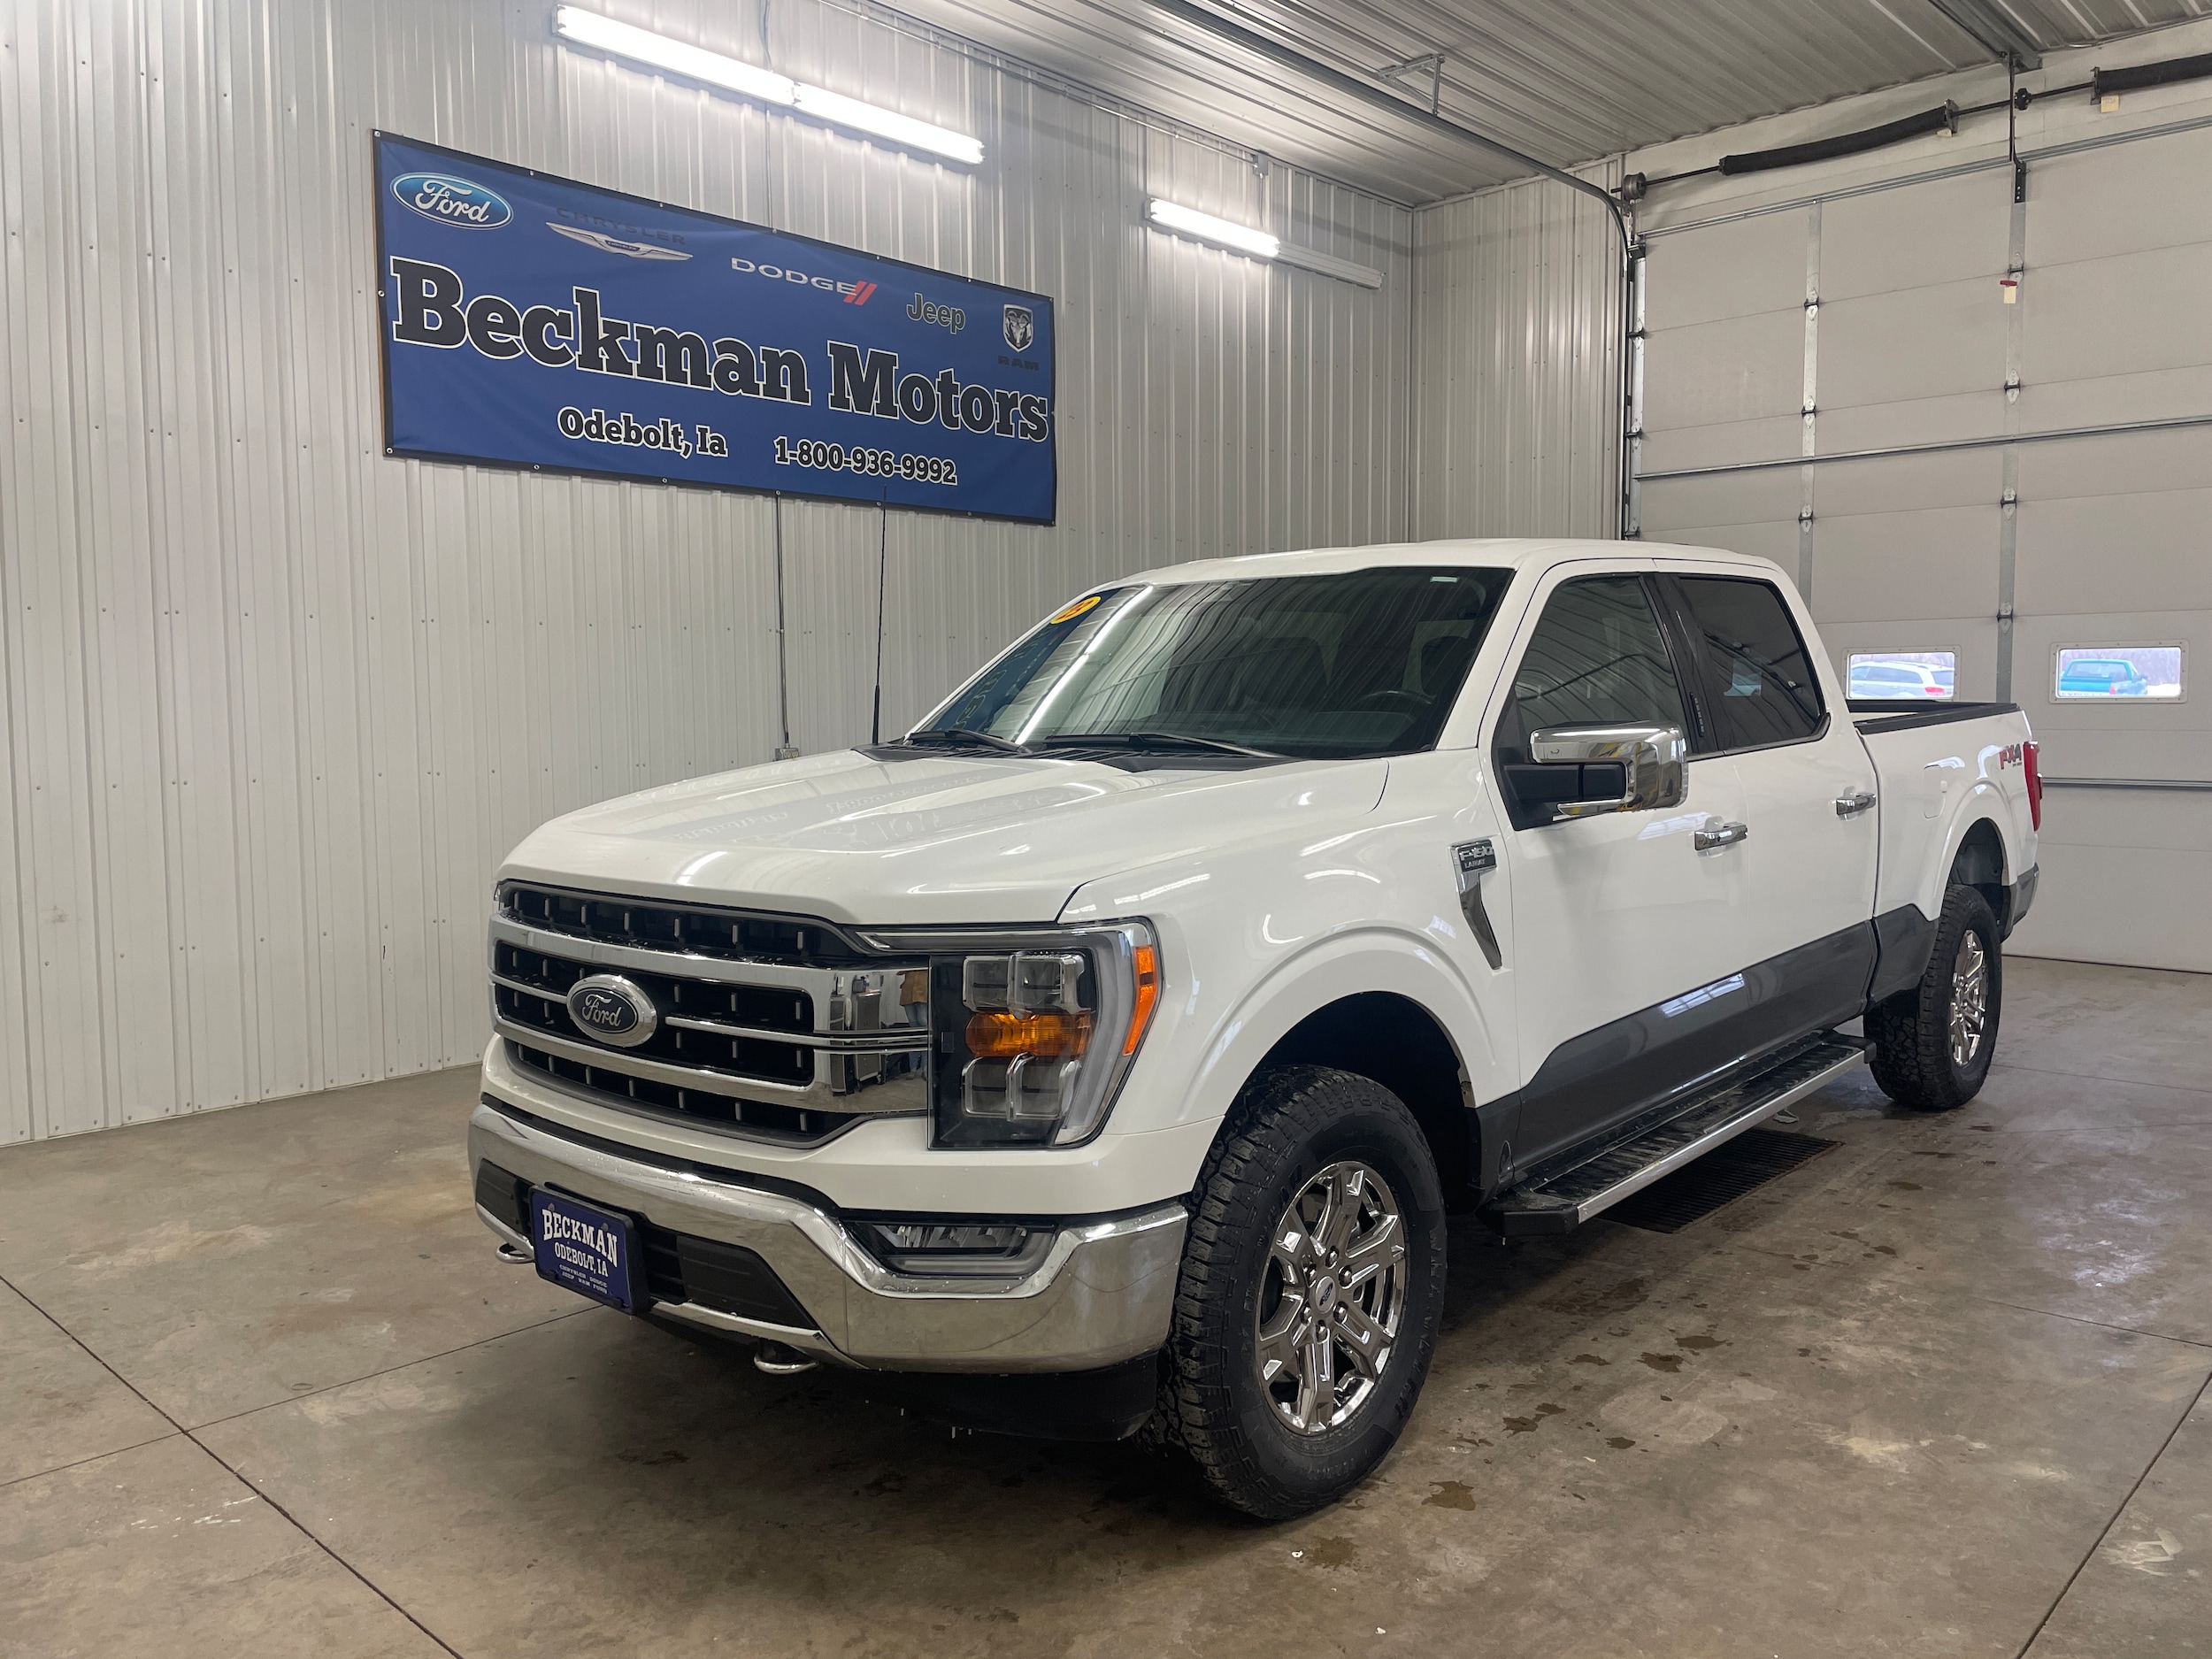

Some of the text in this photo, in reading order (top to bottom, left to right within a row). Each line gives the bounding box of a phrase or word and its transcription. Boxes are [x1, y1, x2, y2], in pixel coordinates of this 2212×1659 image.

[414, 180, 490, 223] Ford
[556, 207, 686, 245] CHRYSLER
[731, 257, 857, 296] DODGE
[906, 293, 965, 334] Jeep
[389, 256, 1048, 442] Beckman Motors
[998, 355, 1039, 372] RAM
[557, 406, 728, 459] Odebolt, Ia
[773, 435, 958, 486] 1-800-936-9992
[1464, 858, 1486, 869] LARIAT
[581, 993, 622, 1027] Ford
[541, 1209, 618, 1268] BECKMAN
[554, 1241, 608, 1277] ODEBOLT, IA
